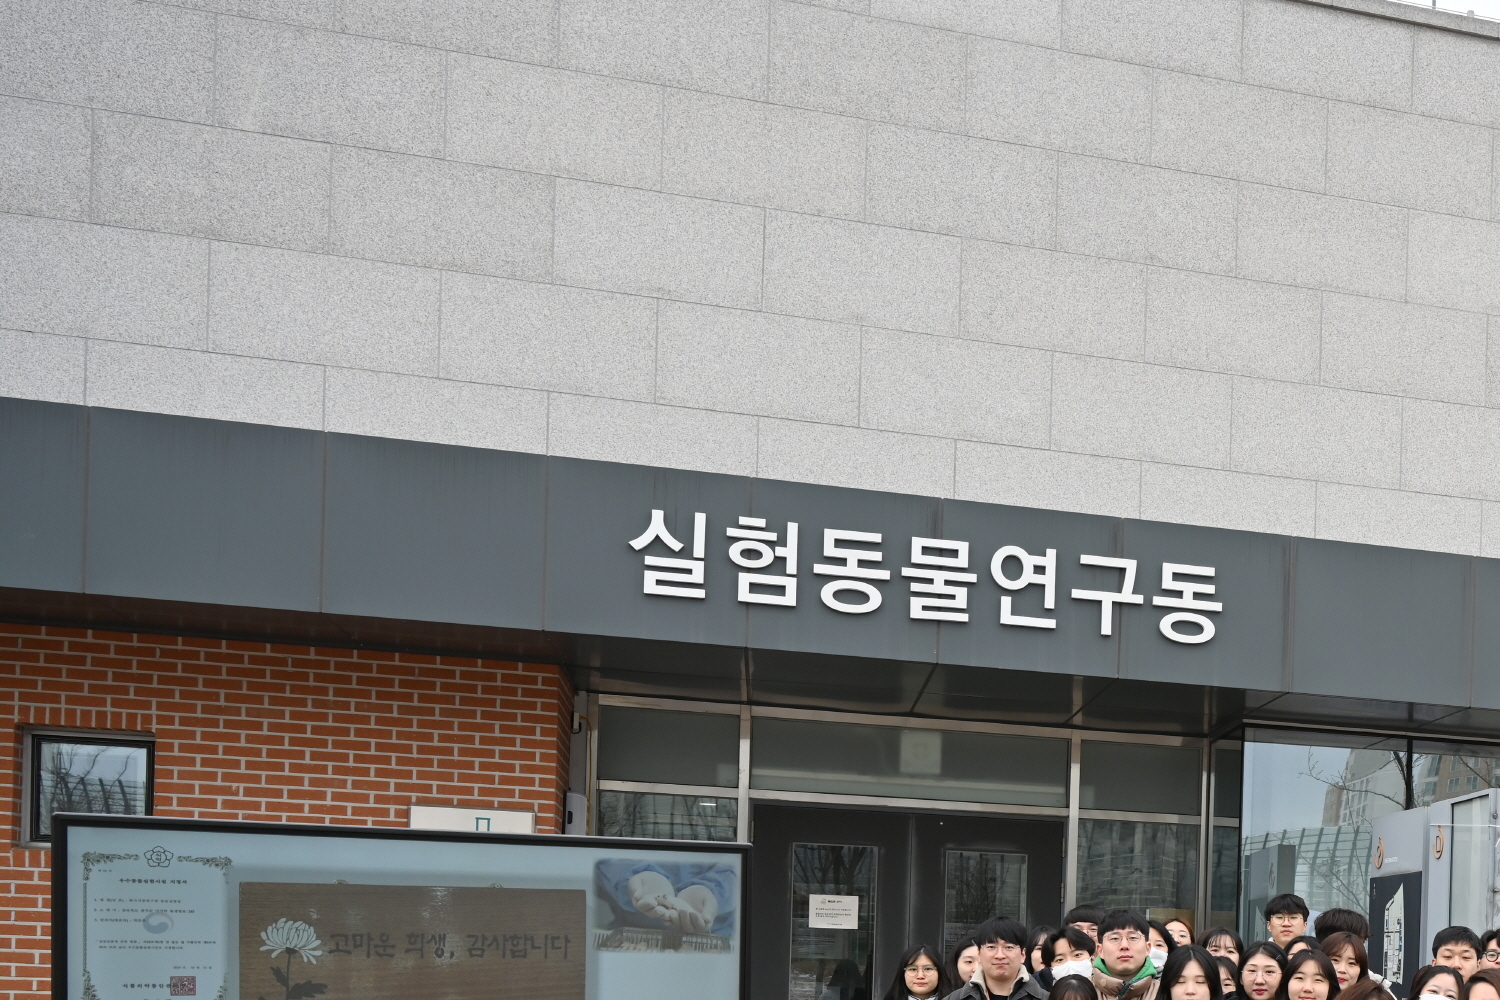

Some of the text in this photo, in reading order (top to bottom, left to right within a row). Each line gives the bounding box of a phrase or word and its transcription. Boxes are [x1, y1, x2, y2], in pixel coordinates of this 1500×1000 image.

[628, 508, 1223, 645] 실험동물연구동
[328, 932, 571, 960] 고마운 희생, 감사합니다
